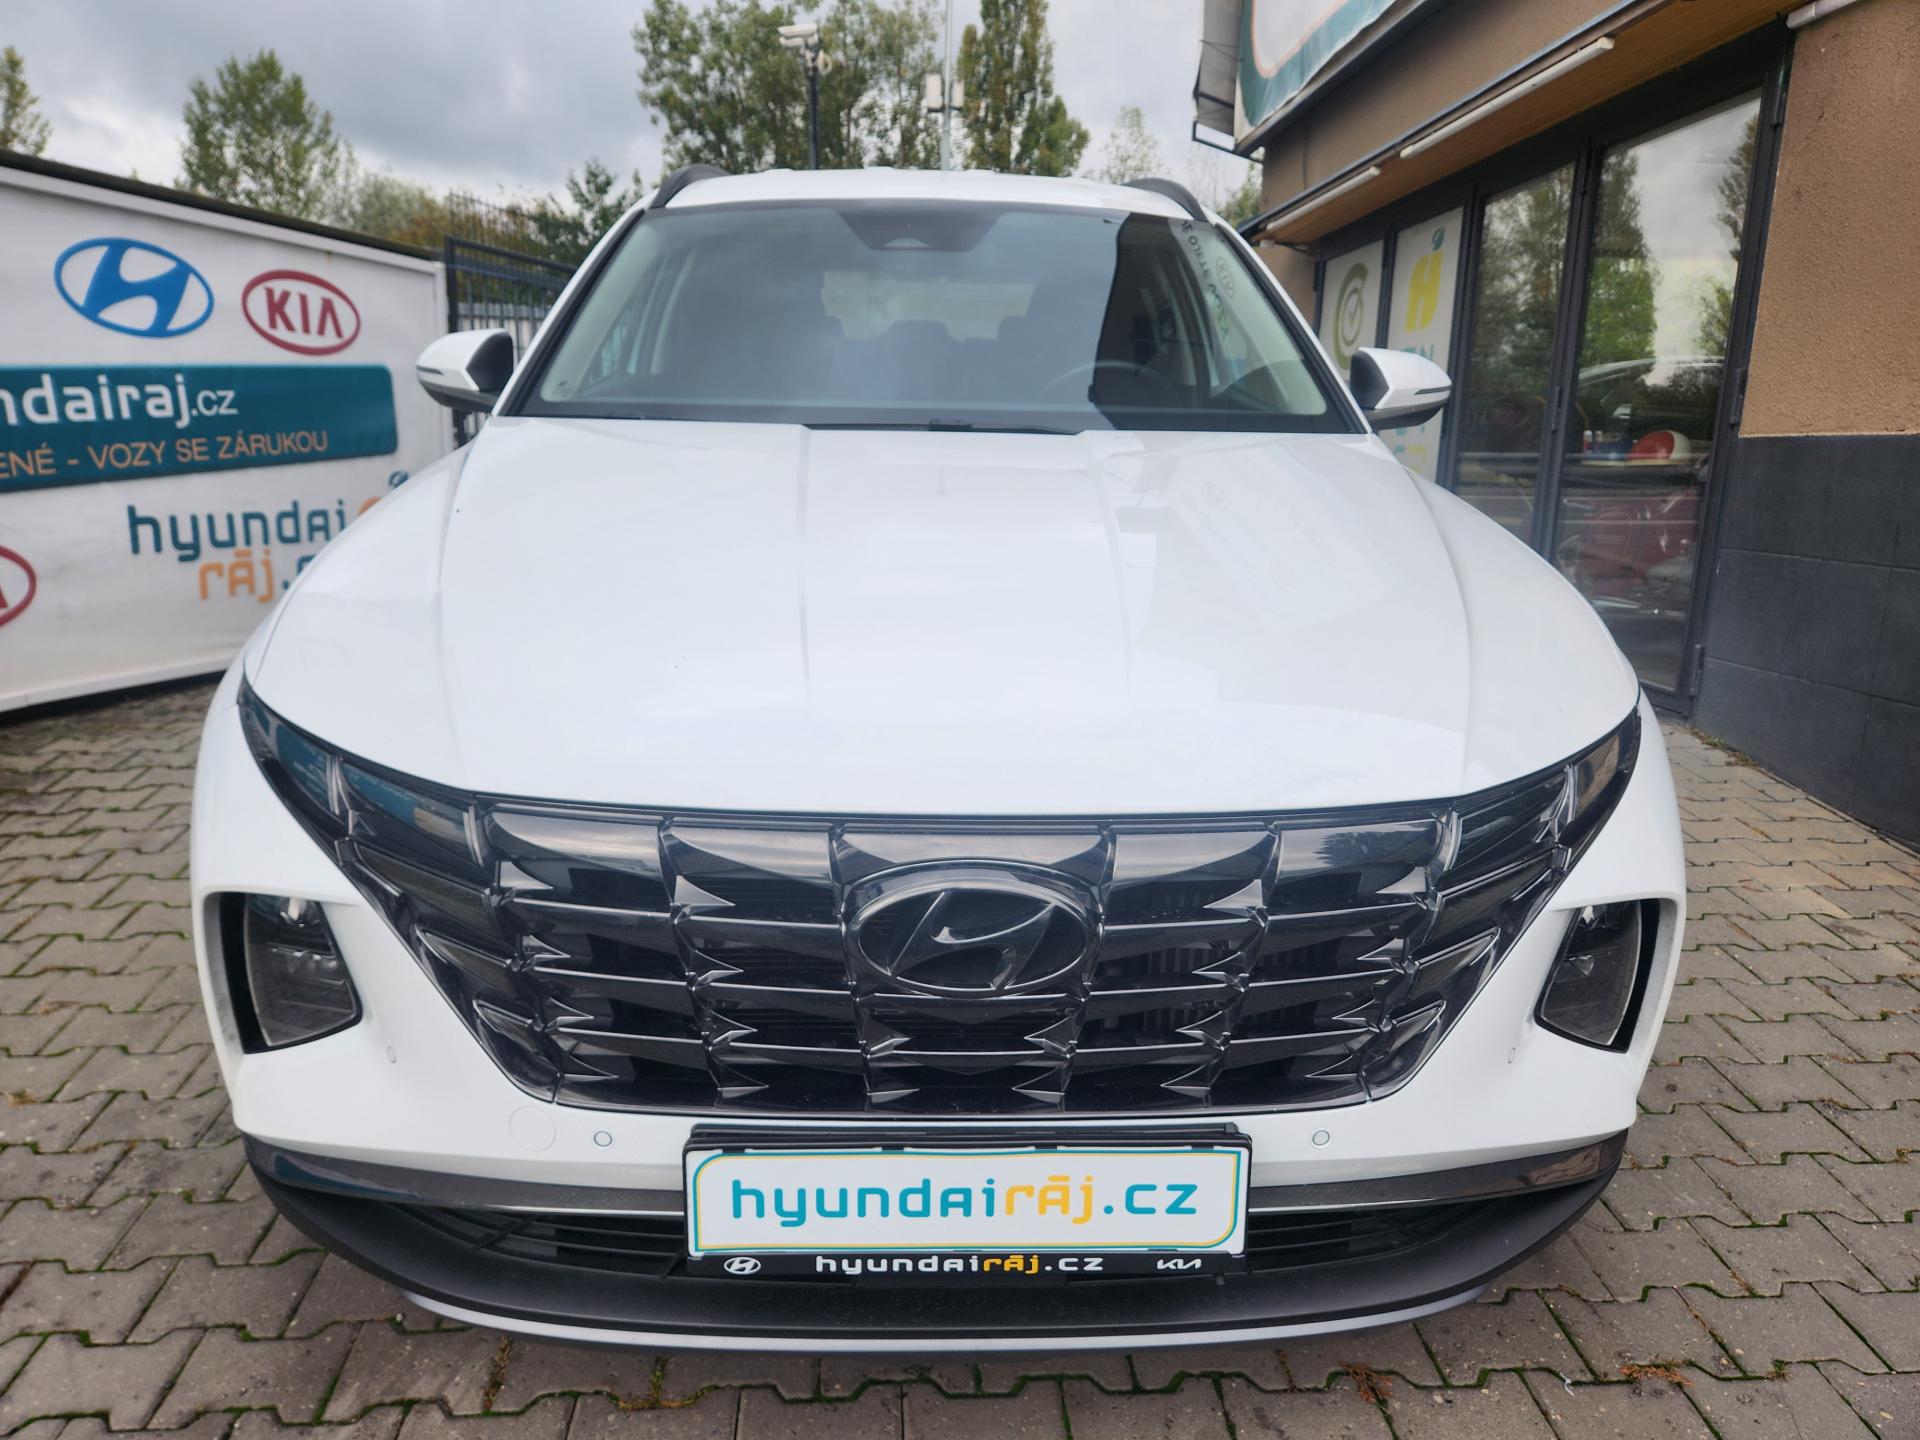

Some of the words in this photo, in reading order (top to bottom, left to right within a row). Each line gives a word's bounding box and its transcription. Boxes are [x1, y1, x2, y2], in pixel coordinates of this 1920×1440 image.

[265, 286, 343, 338] KIA
[87, 441, 166, 469] VOZY
[175, 438, 210, 462] SE
[217, 430, 329, 460] ZÁRUKOU
